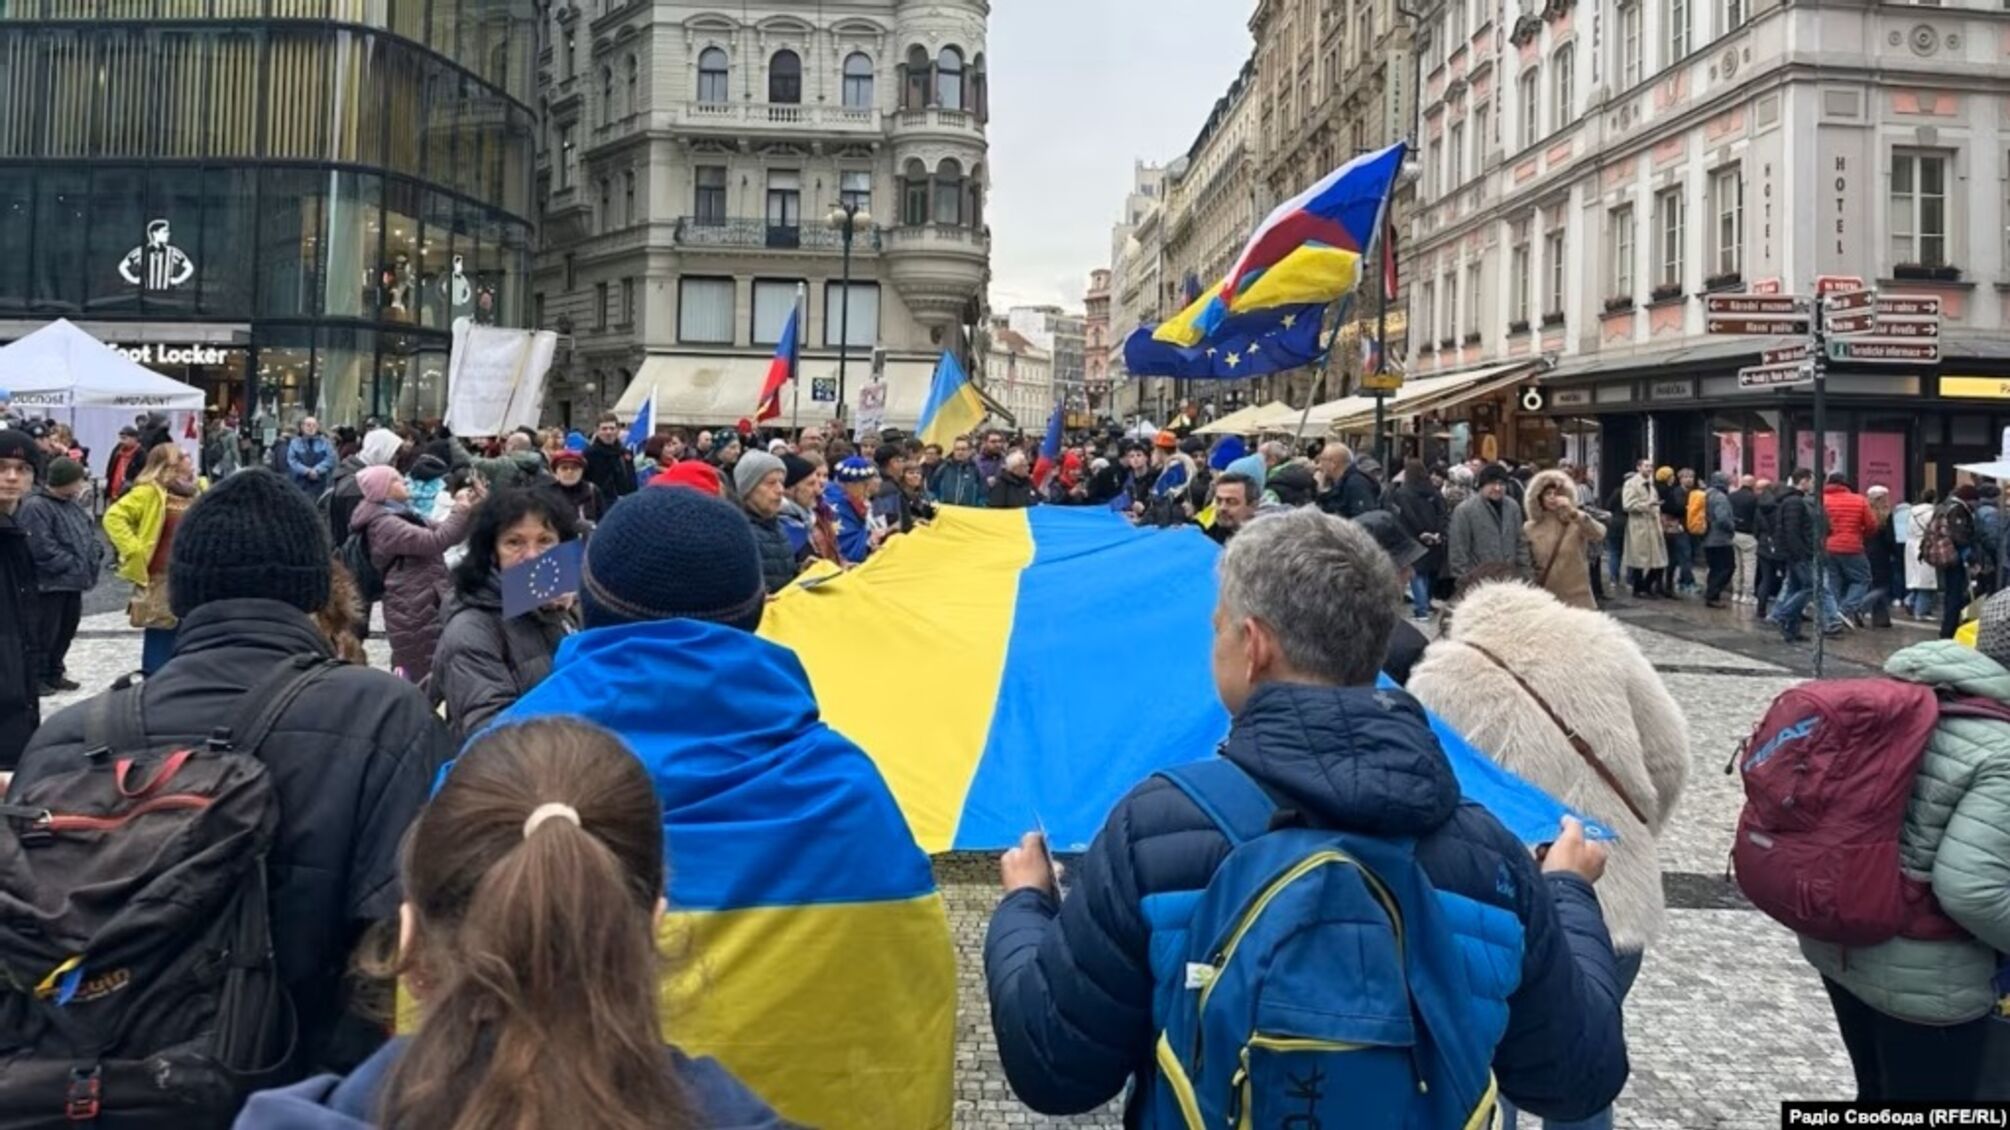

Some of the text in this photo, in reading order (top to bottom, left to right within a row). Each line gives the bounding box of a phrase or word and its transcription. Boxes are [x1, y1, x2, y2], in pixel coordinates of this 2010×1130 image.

[1763, 163, 1771, 259] HOTEL
[1835, 156, 1846, 255] HOTEL
[157, 343, 228, 365] Locker
